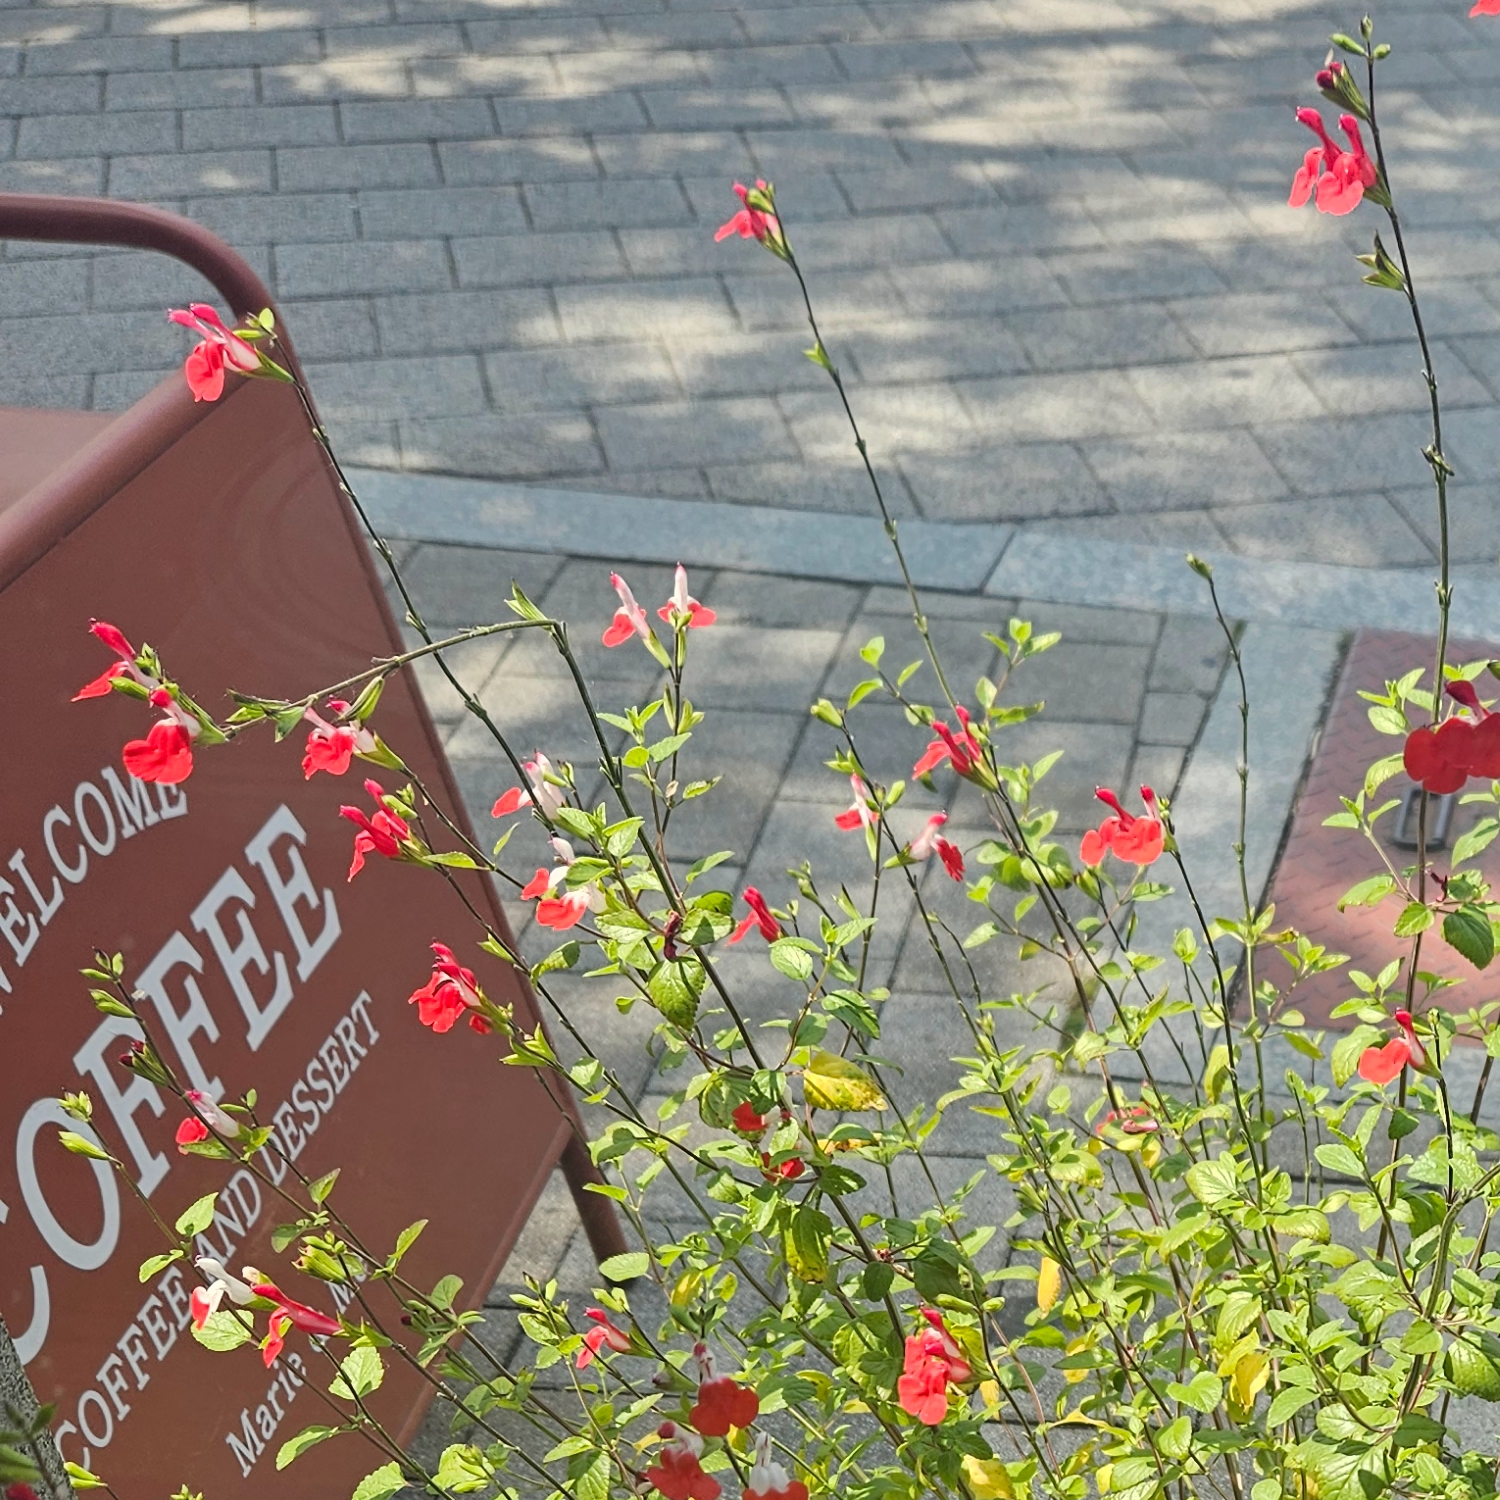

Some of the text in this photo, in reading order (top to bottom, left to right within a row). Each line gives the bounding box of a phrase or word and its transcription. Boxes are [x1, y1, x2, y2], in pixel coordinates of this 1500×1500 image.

[0, 766, 189, 1016] ELCOME
[258, 990, 379, 1187] DESSERT
[225, 1352, 306, 1478] Marie
